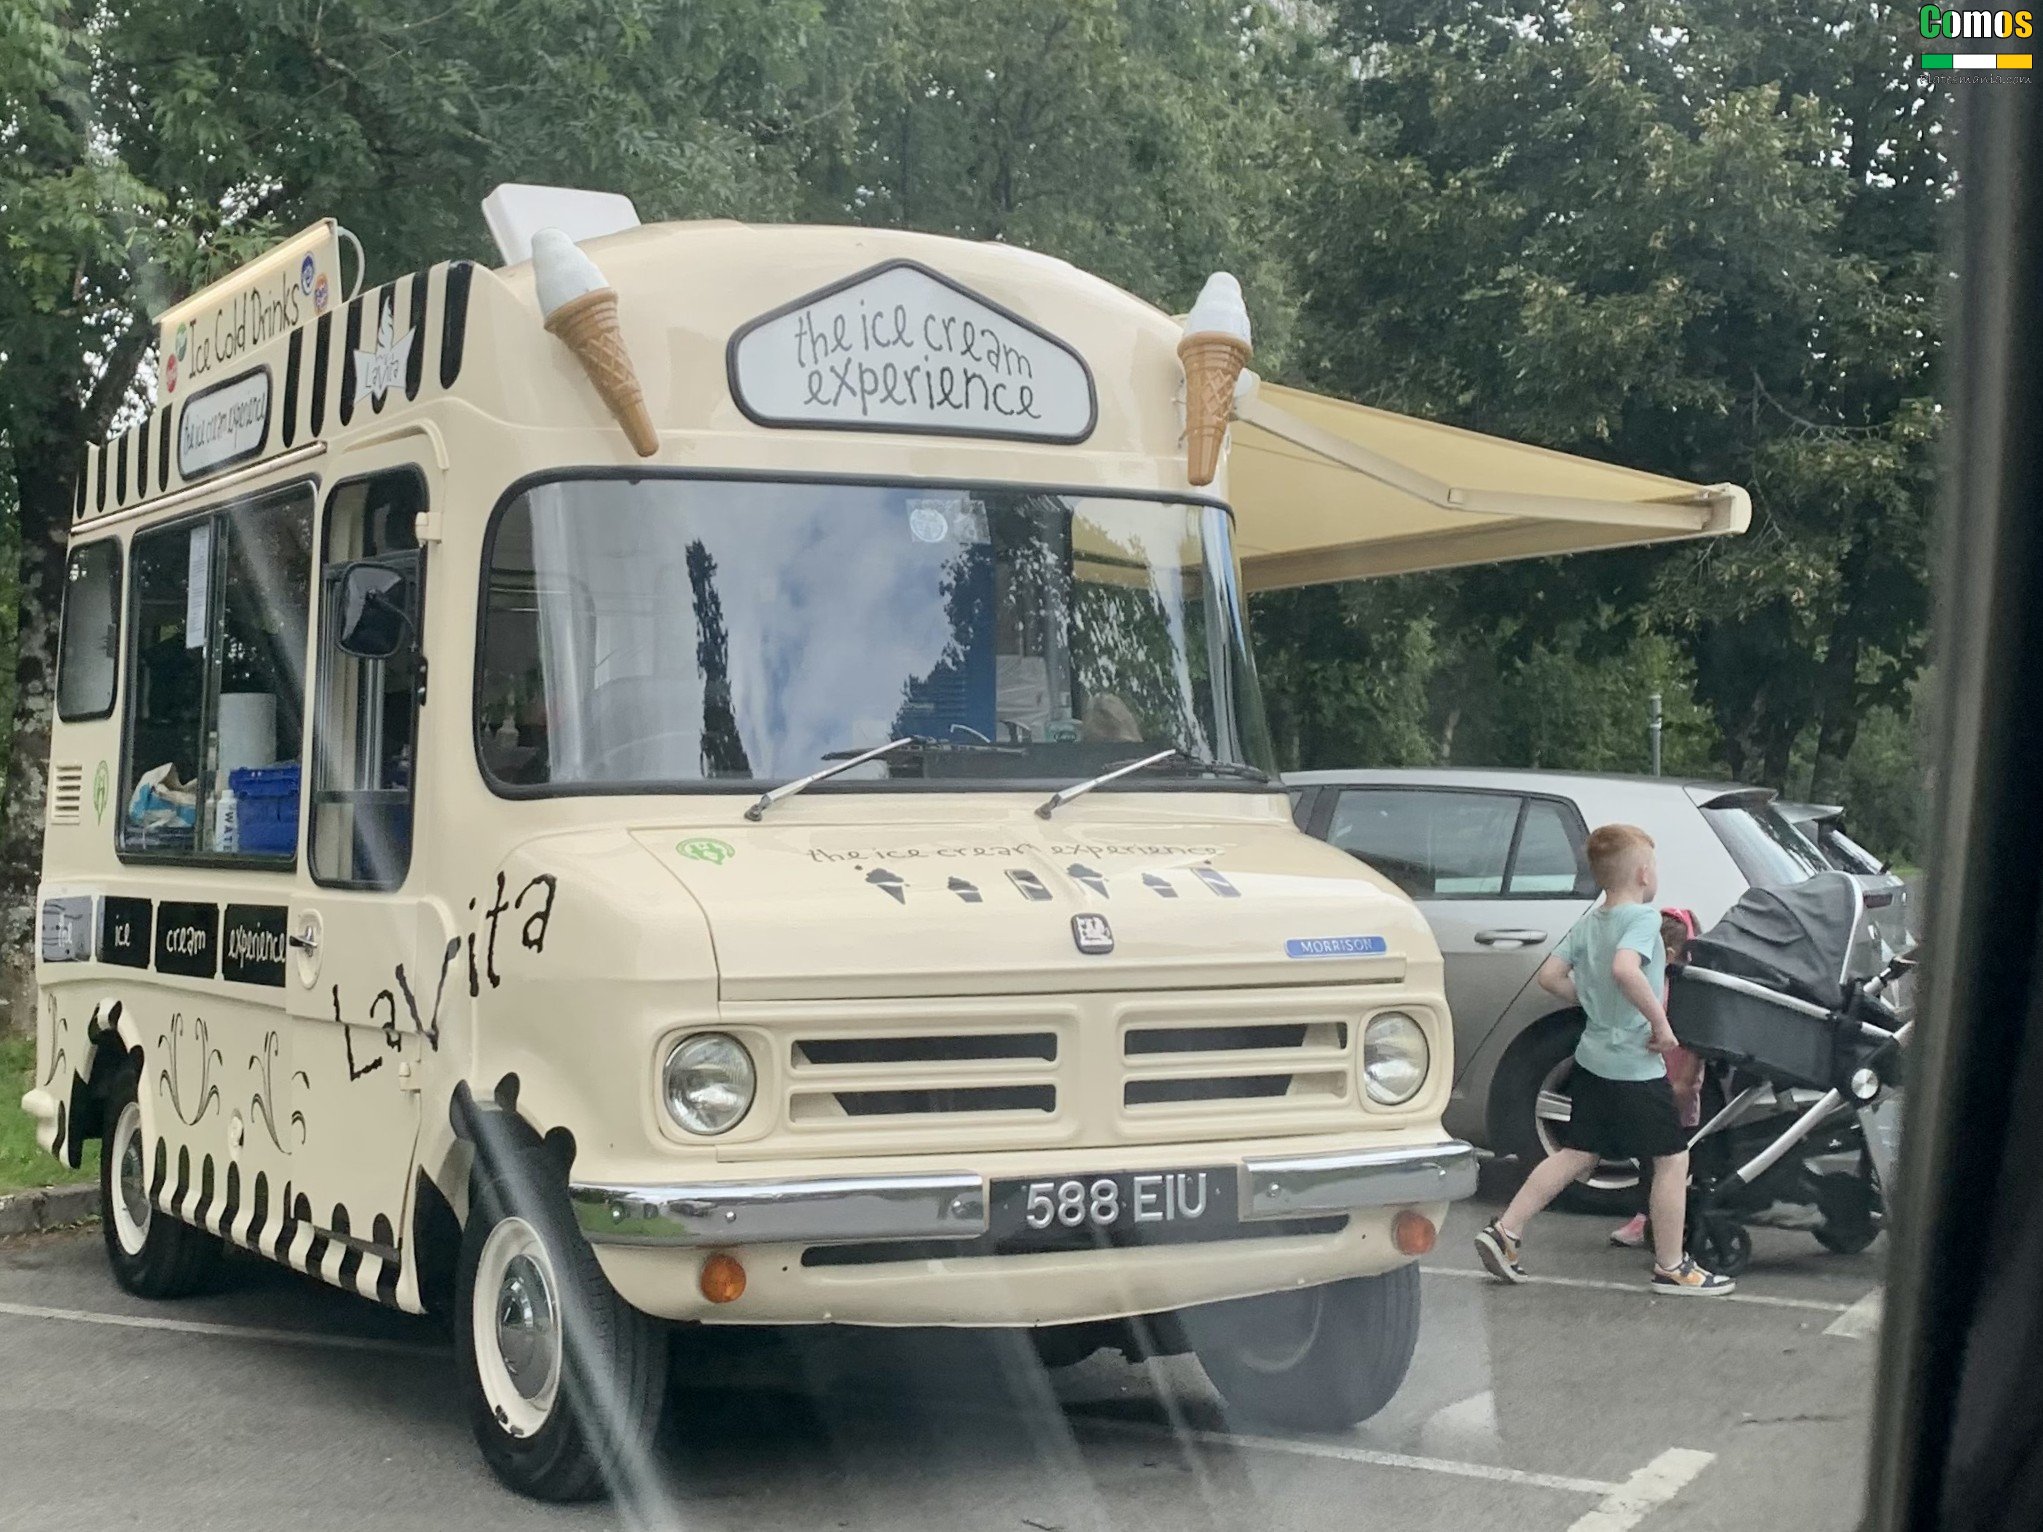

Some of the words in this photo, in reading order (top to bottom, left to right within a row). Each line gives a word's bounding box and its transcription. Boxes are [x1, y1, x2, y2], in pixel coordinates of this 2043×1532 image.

[188, 318, 211, 379] Ice
[214, 292, 247, 363] Cold
[251, 271, 300, 346] Drinks
[795, 310, 853, 368] the
[860, 300, 914, 352] ice
[923, 313, 1033, 379] cream
[803, 354, 1042, 419] experience
[223, 811, 234, 852] WATE
[806, 848, 868, 862] the
[871, 847, 929, 859] ice
[1051, 844, 1225, 859] experience
[114, 914, 131, 947] ice
[166, 926, 206, 955] cream
[228, 922, 286, 969] experience
[1300, 937, 1373, 955] MORRISON
[1027, 1180, 1120, 1230] 588
[1133, 1173, 1207, 1223] EIU
